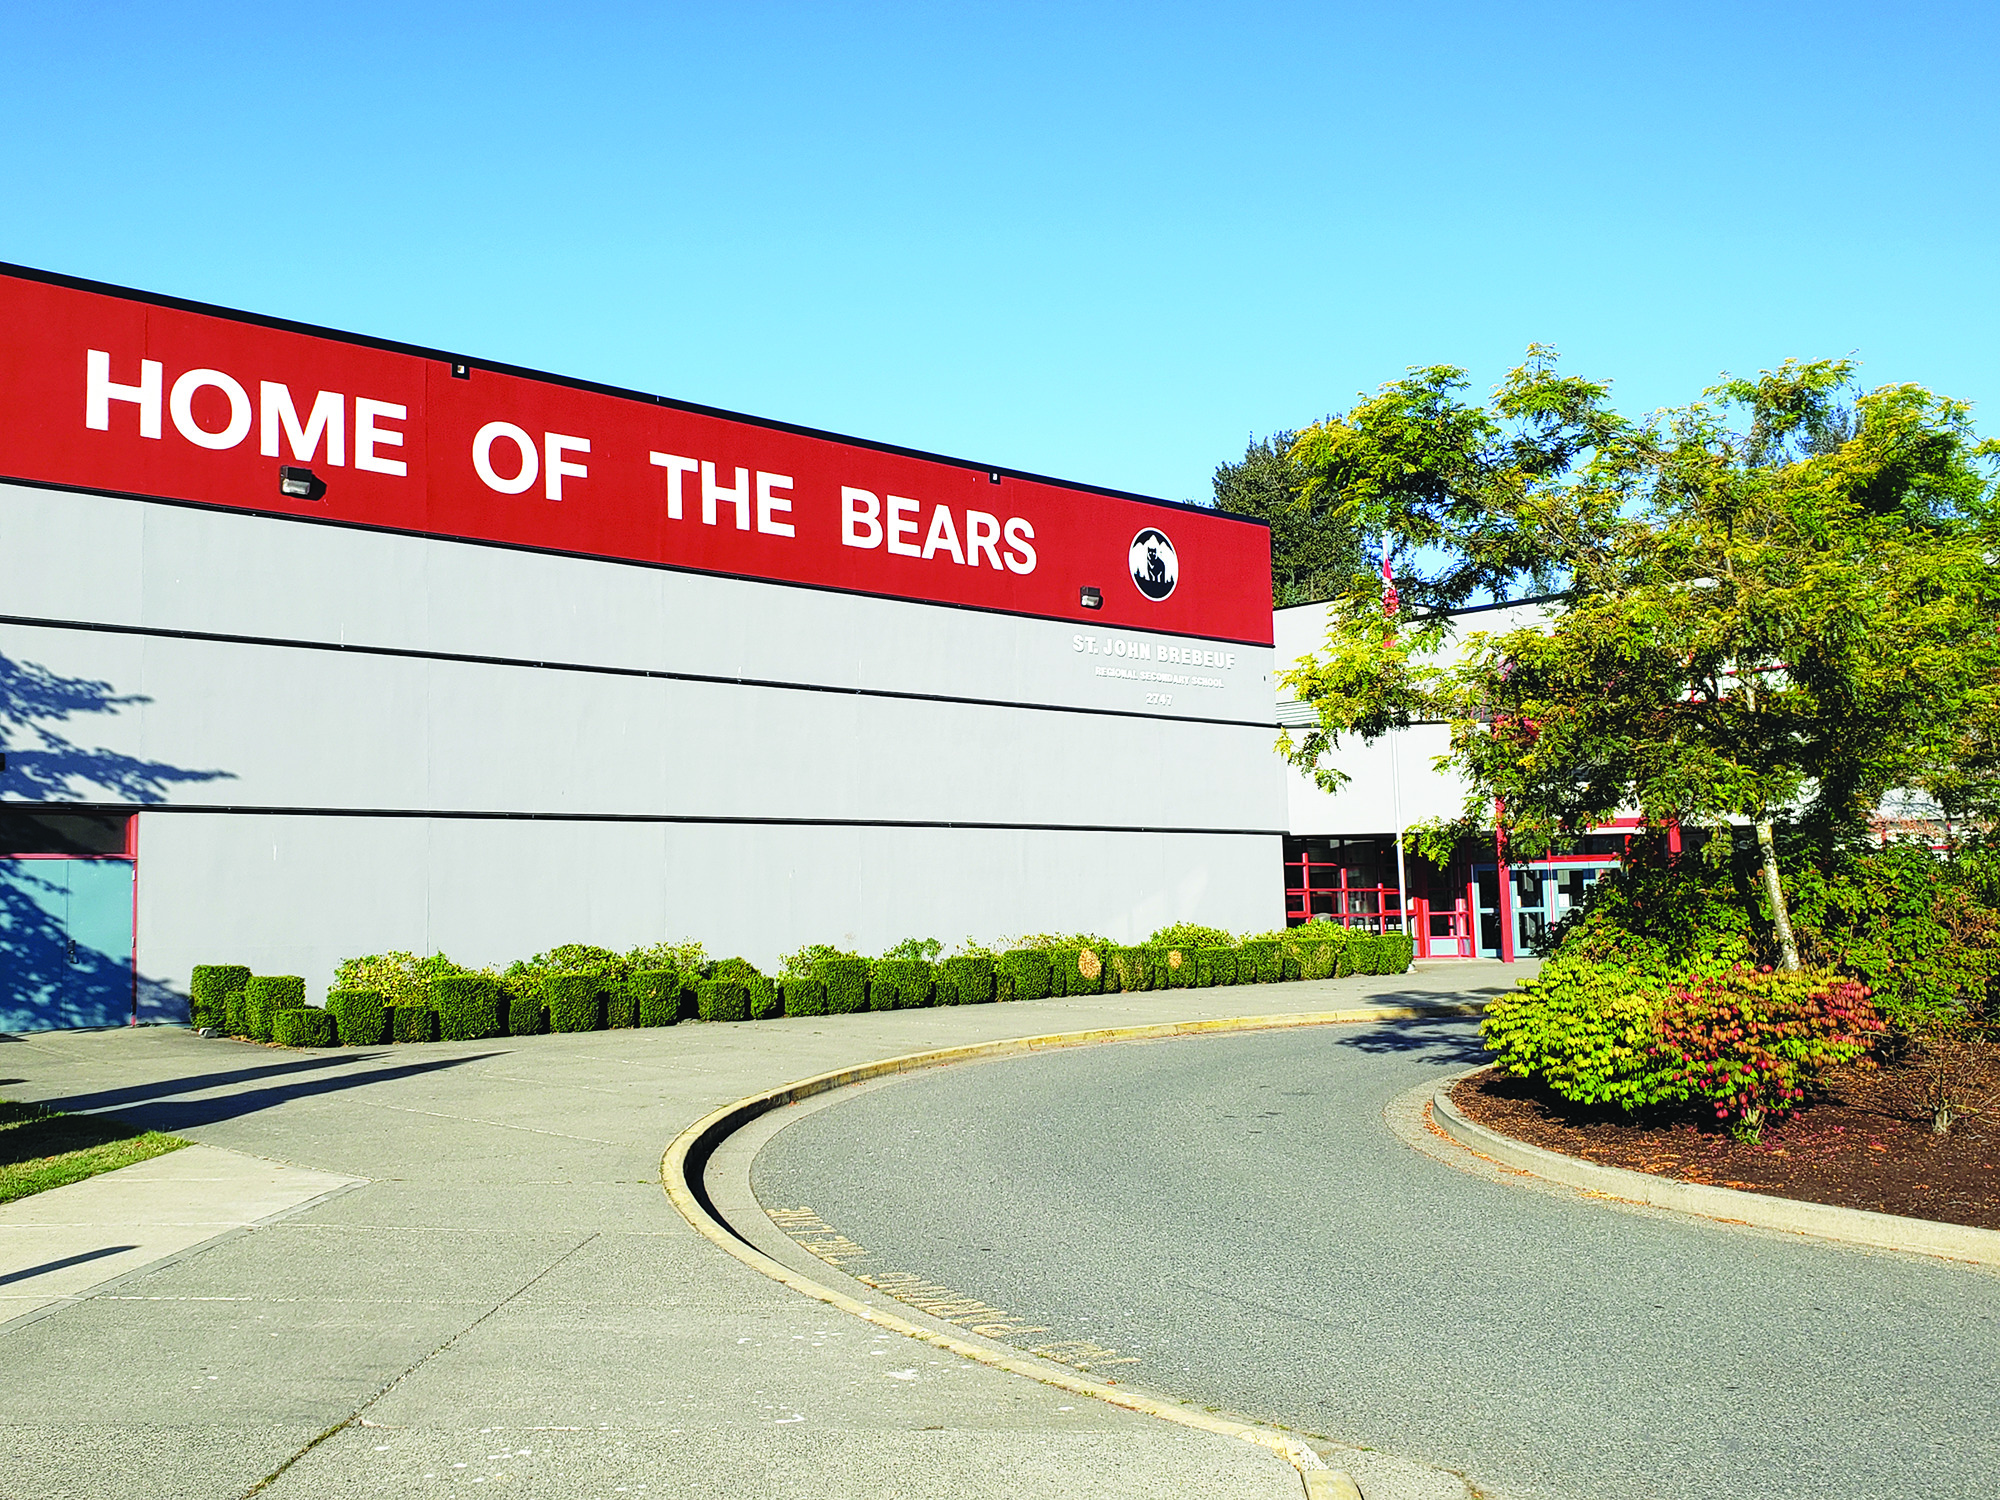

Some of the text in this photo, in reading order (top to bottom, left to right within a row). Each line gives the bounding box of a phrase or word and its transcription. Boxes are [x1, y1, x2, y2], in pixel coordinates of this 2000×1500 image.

[85, 349, 1037, 575] HOME OF THE BEARS
[1072, 634, 1235, 669] ST. JOHN BREBEUF
[1096, 666, 1224, 688] REGIONAL SECONDARY SCHOOL
[1146, 692, 1173, 706] 2747
[766, 1206, 837, 1235] LANE
[857, 1272, 1050, 1338] PARKING
